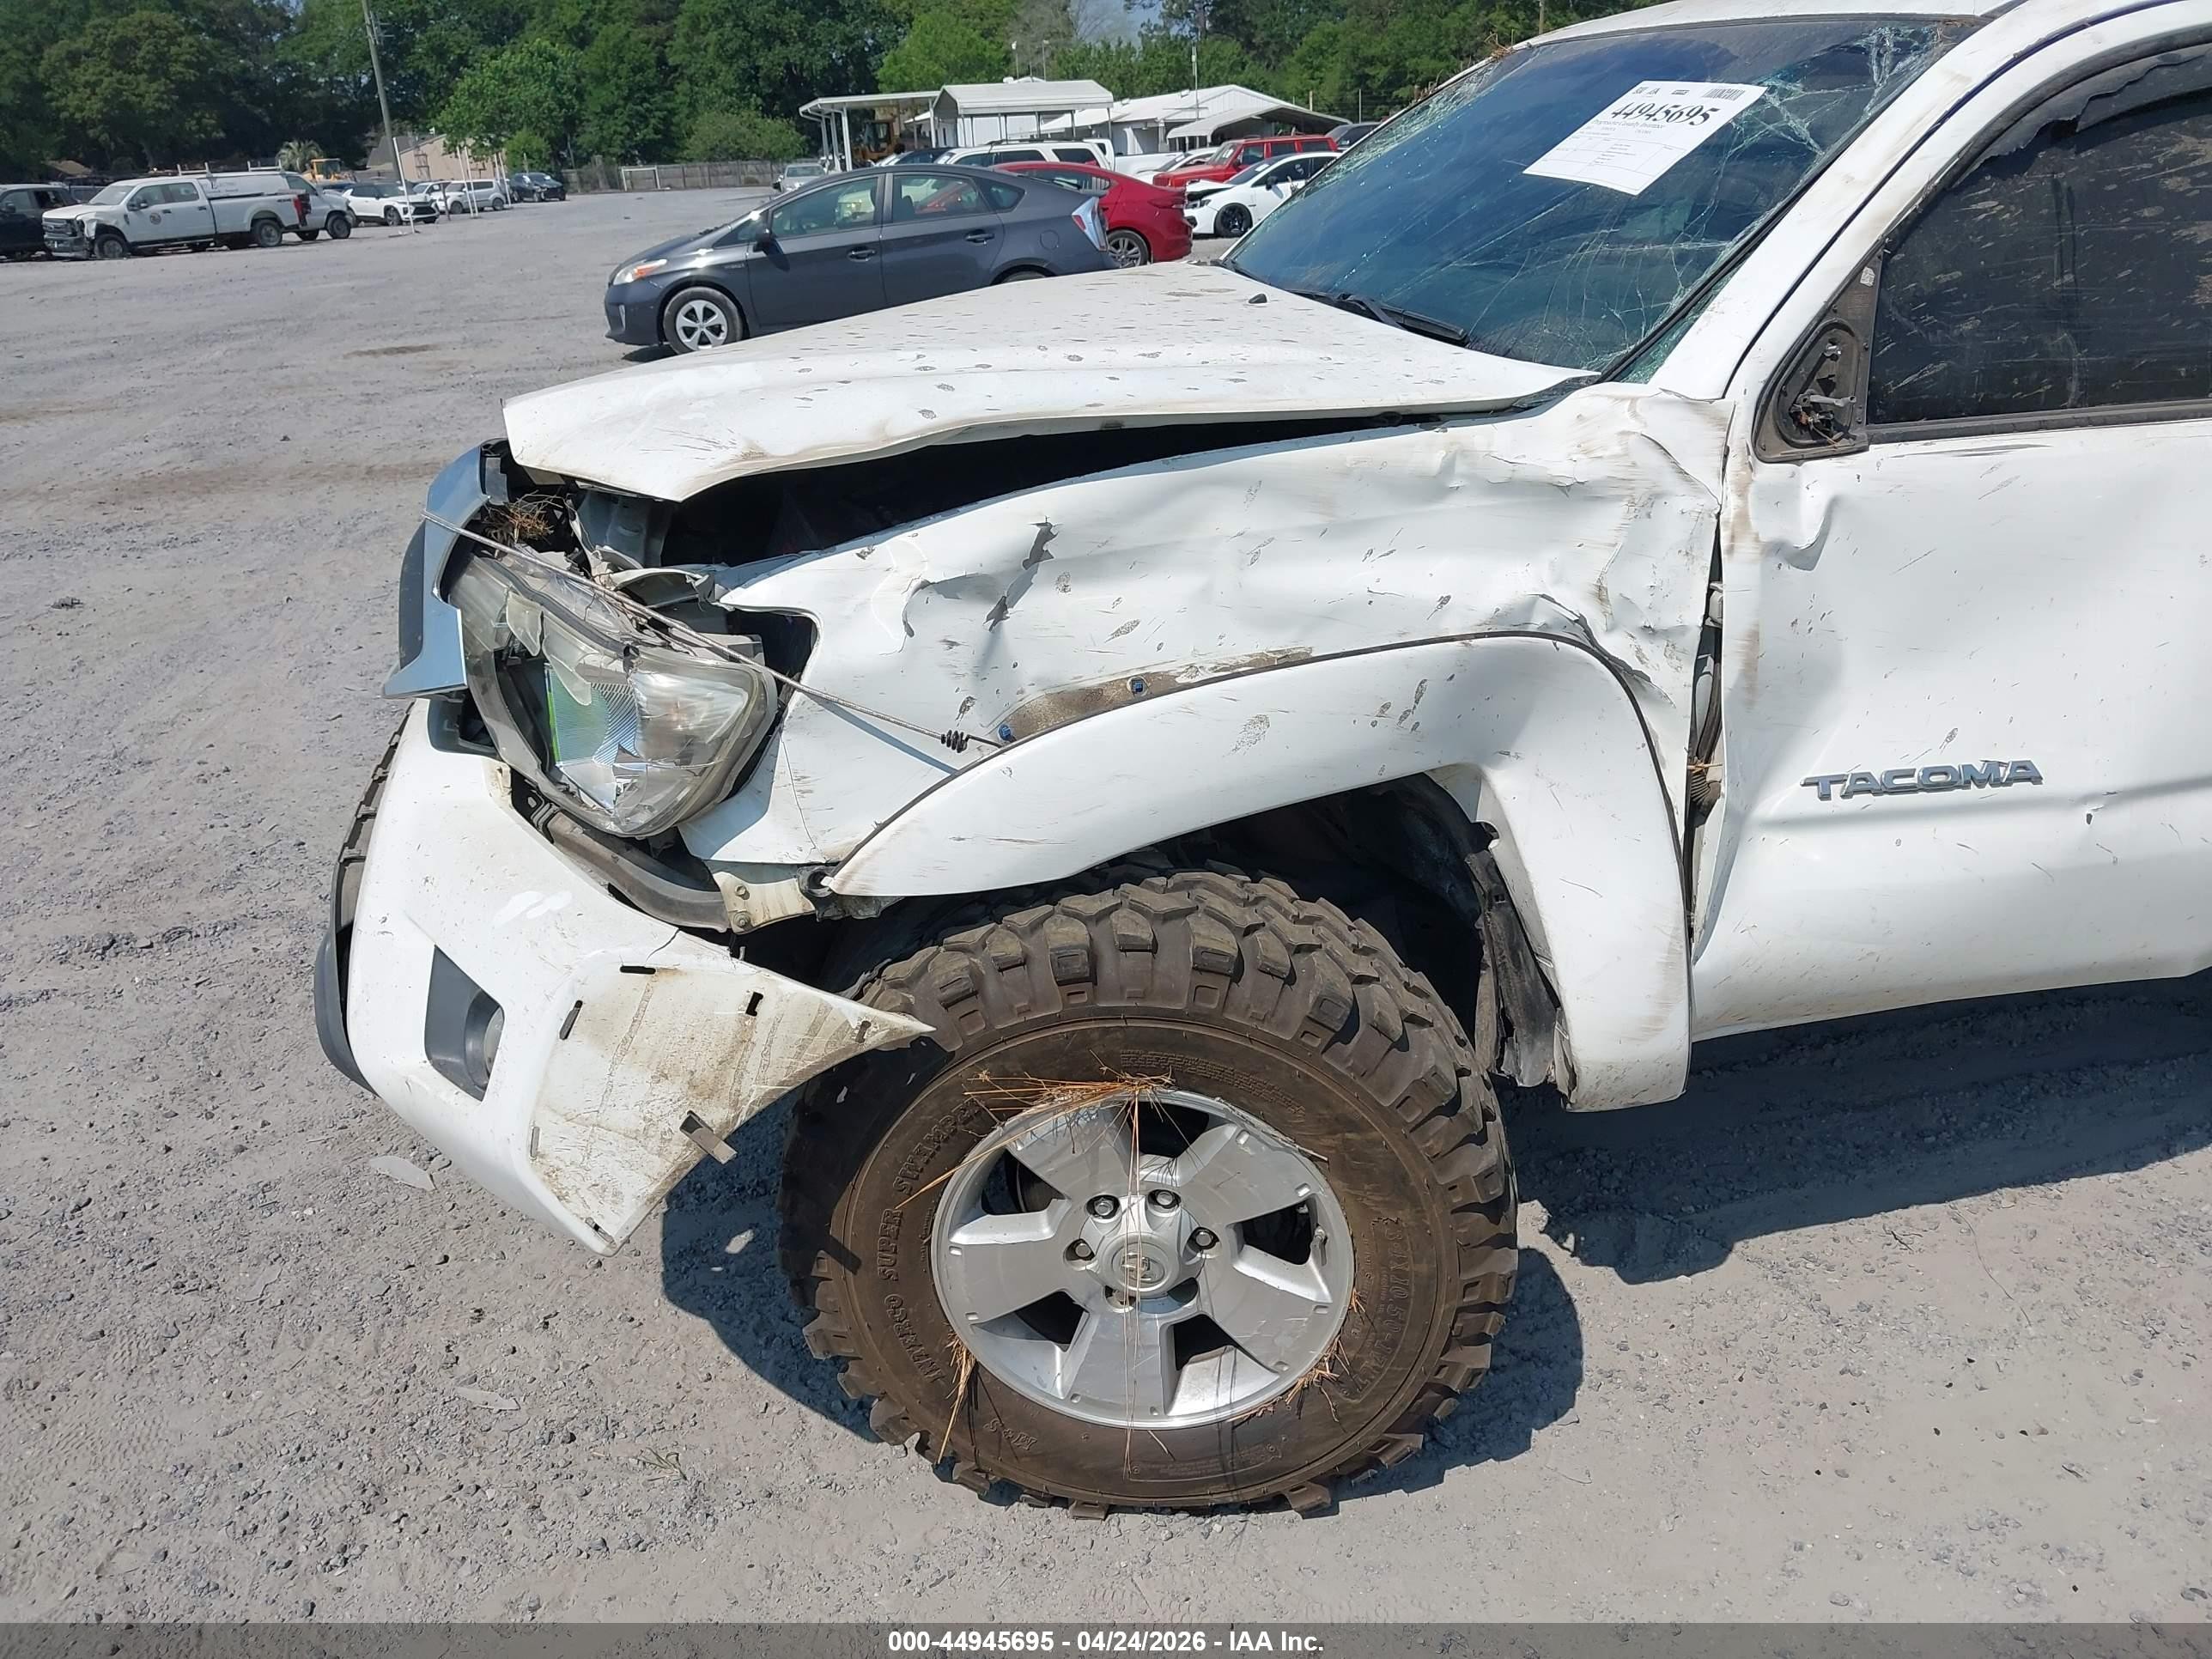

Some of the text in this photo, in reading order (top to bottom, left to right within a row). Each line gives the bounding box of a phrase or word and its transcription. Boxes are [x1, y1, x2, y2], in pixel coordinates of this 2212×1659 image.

[1612, 102, 1720, 126] 44945695
[1801, 760, 2044, 801] TACOMA
[878, 1208, 904, 1282] SUPER
